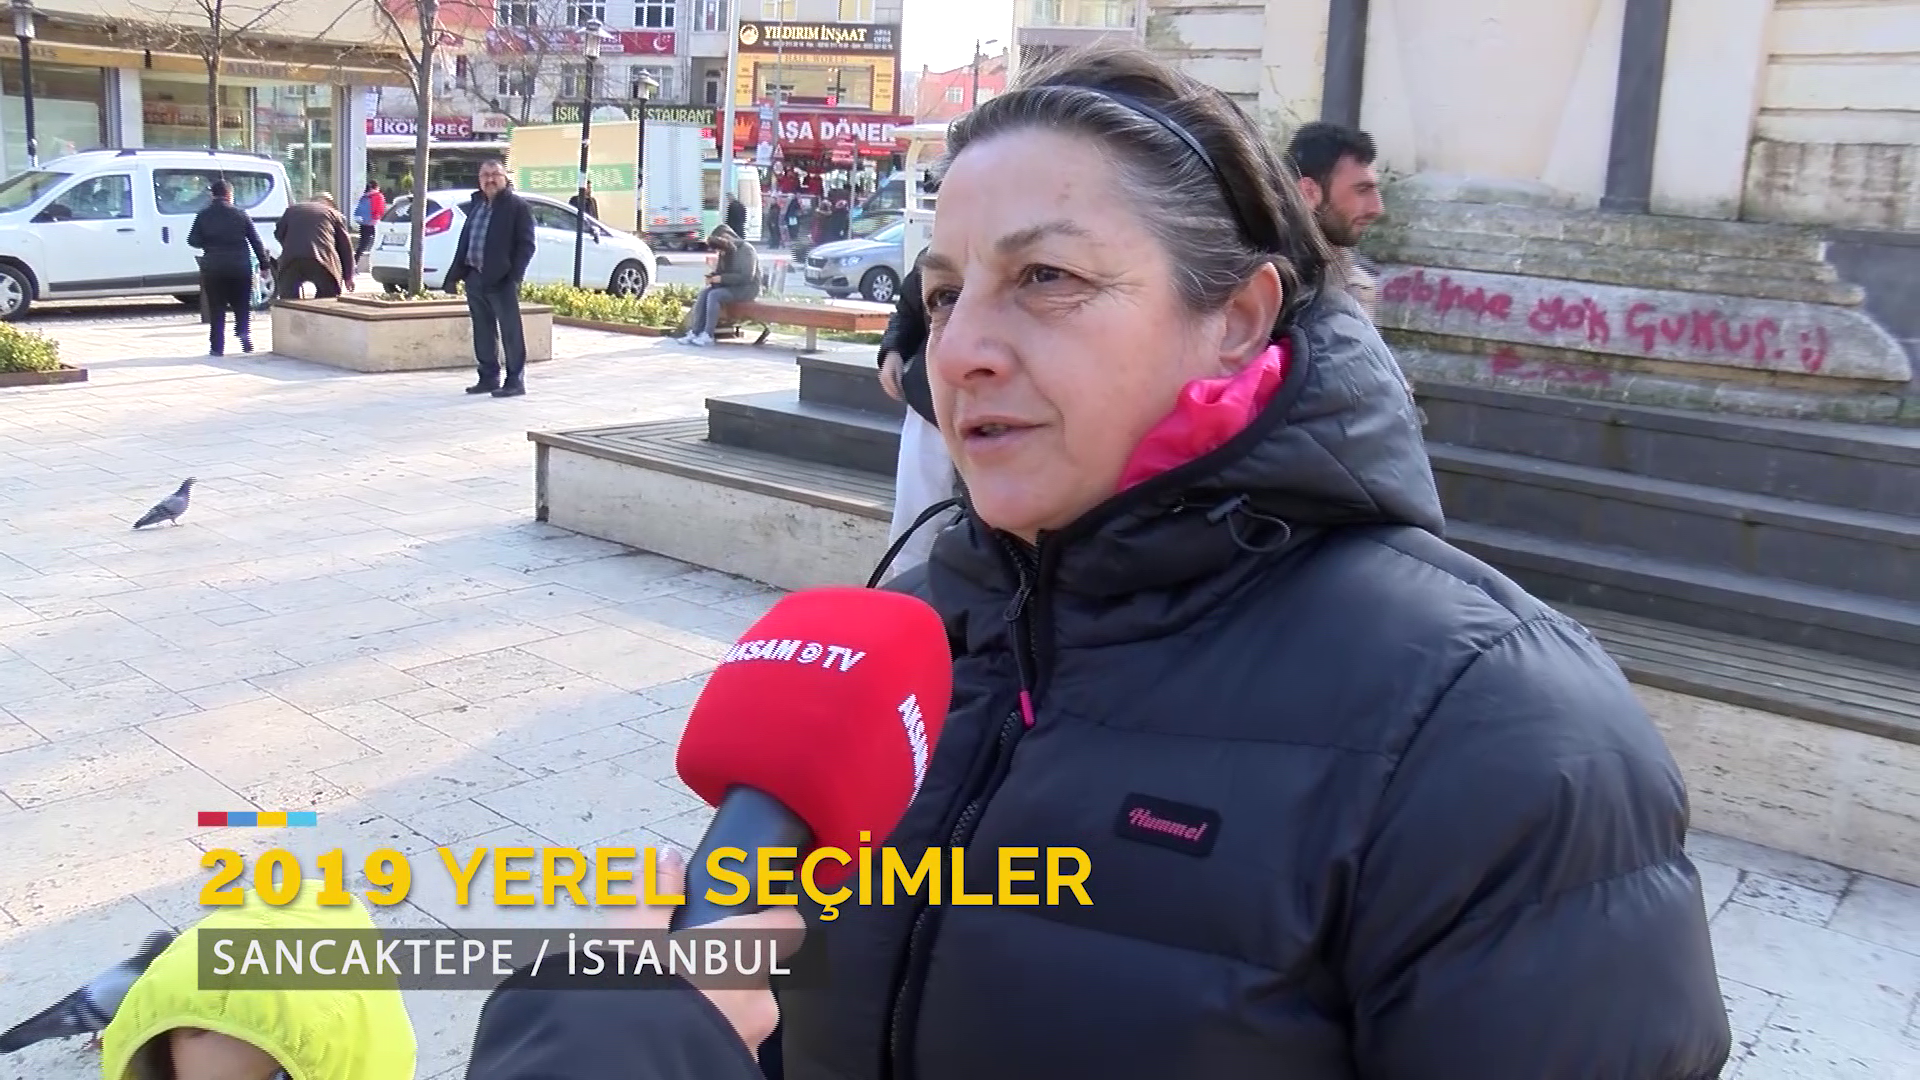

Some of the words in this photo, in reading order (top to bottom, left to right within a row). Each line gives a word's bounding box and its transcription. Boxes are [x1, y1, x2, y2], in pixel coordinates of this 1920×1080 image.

[764, 25, 819, 40] YILDIRIM
[821, 24, 867, 43] İNŞAAT
[631, 106, 714, 124] RSTAURANT
[384, 121, 470, 137] KOKREÇ
[820, 117, 896, 142] DÖNER
[529, 167, 623, 188] BELLNA
[822, 644, 867, 672] TV
[1129, 807, 1208, 841] Hummel
